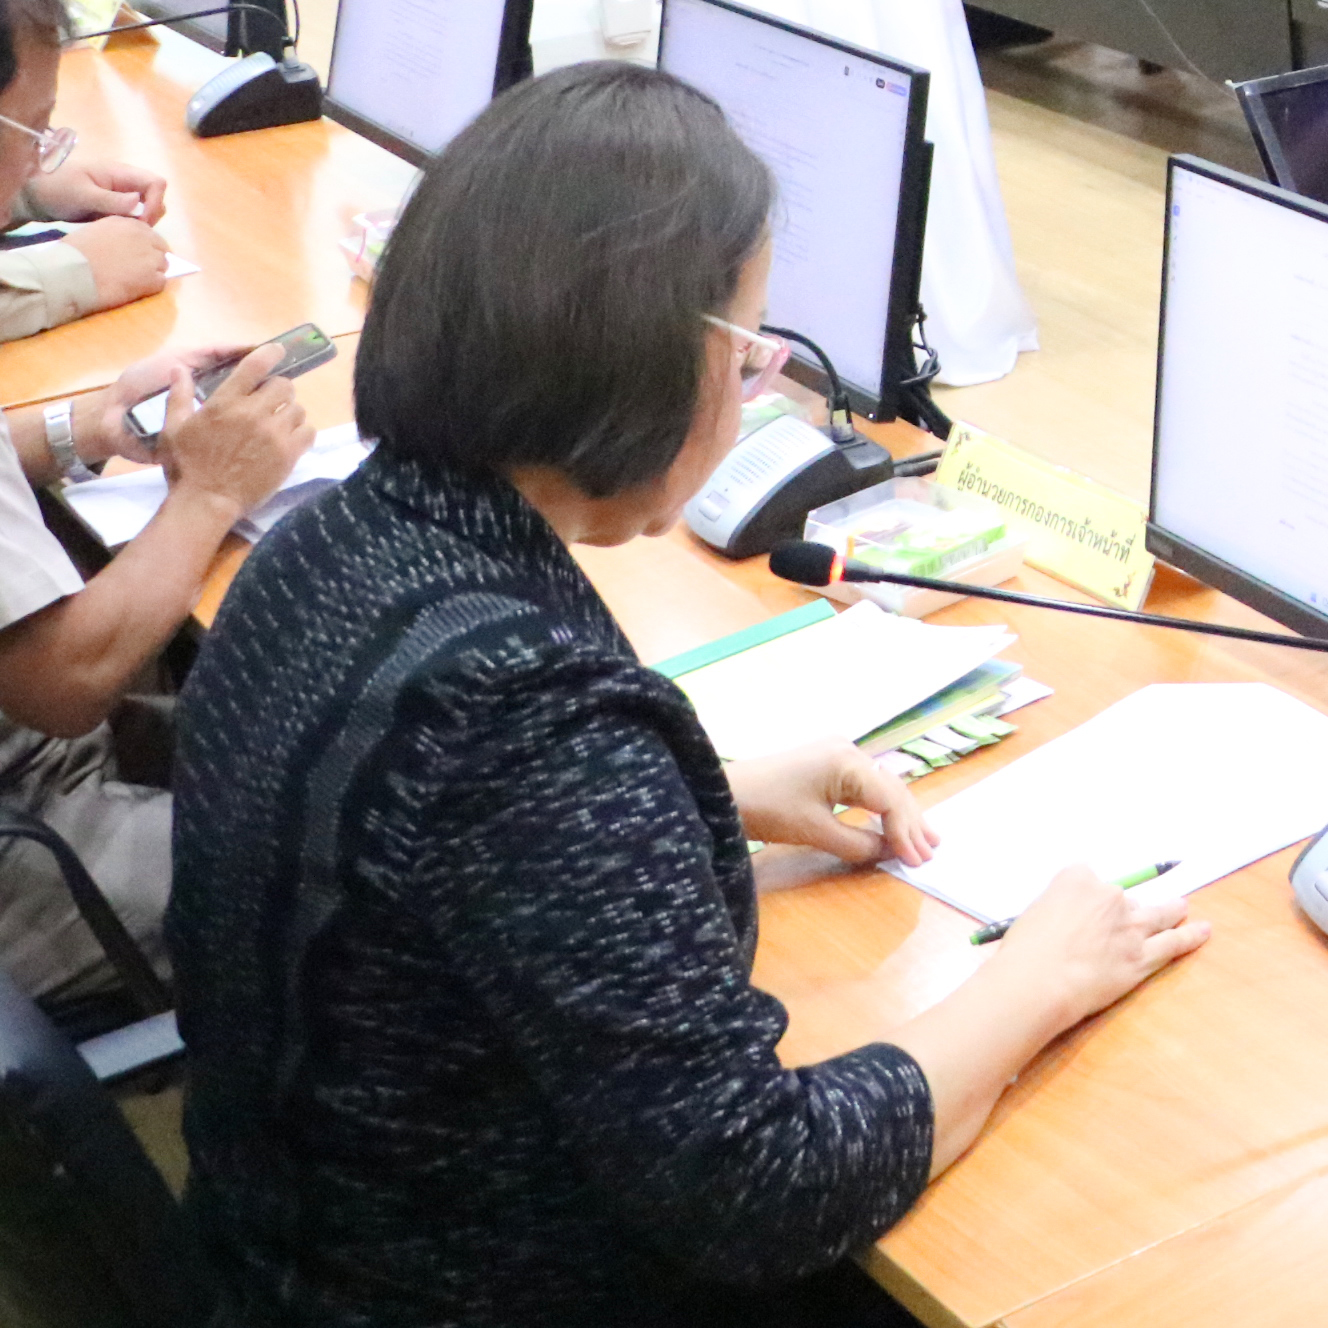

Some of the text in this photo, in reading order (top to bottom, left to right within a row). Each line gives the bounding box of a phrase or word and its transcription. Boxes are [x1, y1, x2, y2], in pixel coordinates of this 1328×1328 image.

[957, 460, 1137, 565] ผู้อำนวยการกองการเจ้าหน้าที่
